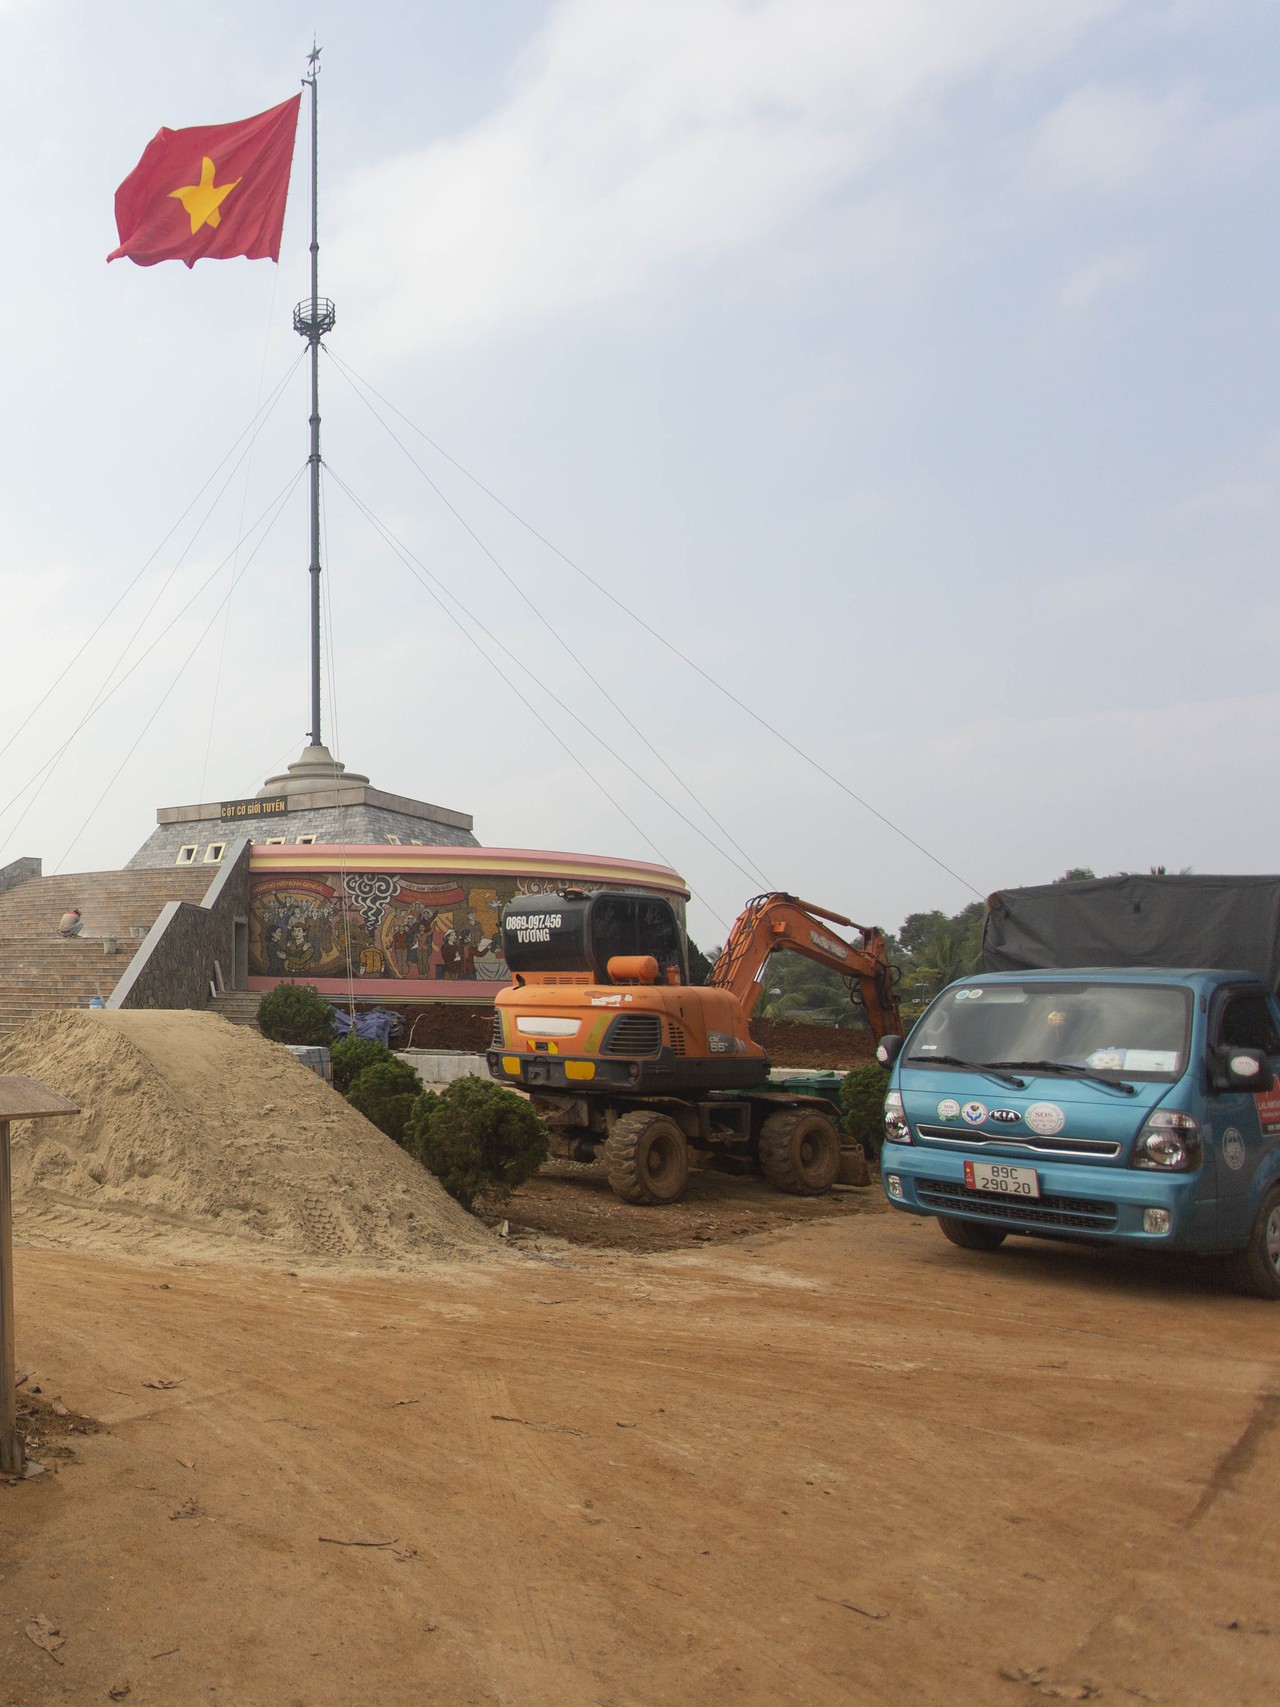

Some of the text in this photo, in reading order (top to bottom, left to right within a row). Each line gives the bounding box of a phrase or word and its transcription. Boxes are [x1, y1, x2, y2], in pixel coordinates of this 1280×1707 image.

[221, 799, 285, 819] CỘT CỜ GIỚI TUYẾN
[517, 928, 550, 943] VƯƠNG
[994, 1111, 1016, 1121] KIA
[991, 1165, 1019, 1180] 89C
[981, 1177, 1031, 1195] 290.20
